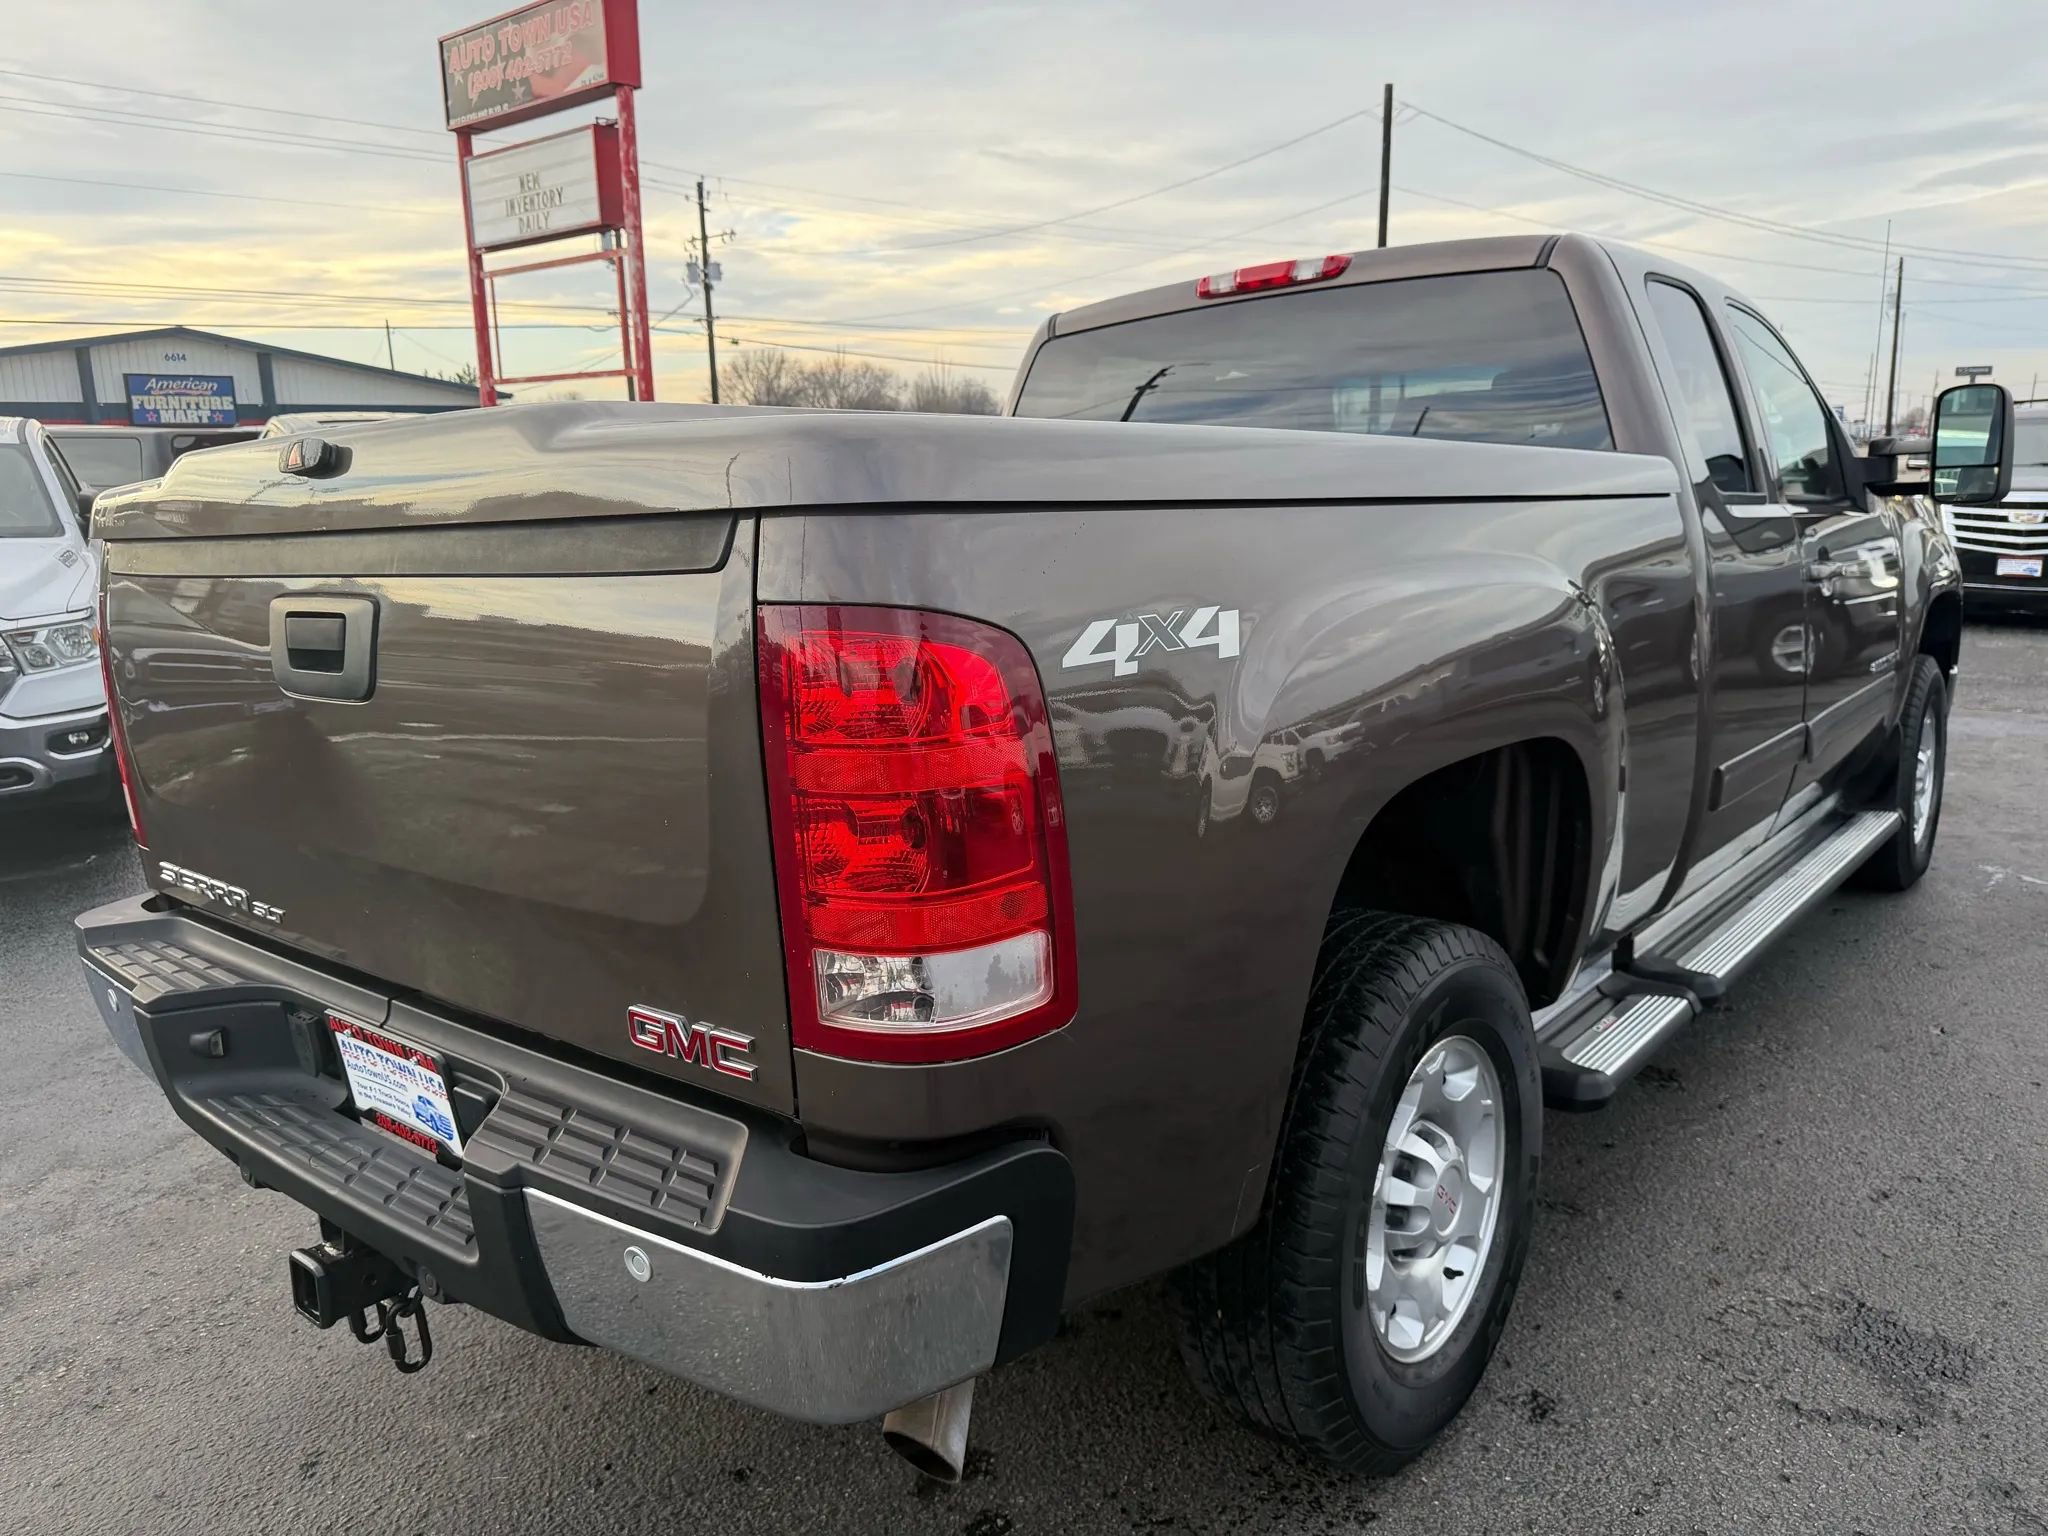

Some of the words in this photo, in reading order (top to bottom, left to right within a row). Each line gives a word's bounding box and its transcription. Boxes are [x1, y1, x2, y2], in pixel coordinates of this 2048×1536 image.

[448, 34, 496, 74] AUTO
[498, 13, 551, 56] TOWN
[555, 1, 594, 36] USA
[504, 186, 563, 217] INVENTORY
[518, 211, 550, 233] DAILY
[164, 353, 187, 362] 6614
[145, 377, 218, 392] American
[131, 395, 235, 411] FURNITURE
[160, 410, 212, 424] MART
[159, 861, 250, 912] SIERRA
[329, 1015, 364, 1041] AUTO
[364, 1029, 405, 1061] TOWN
[405, 1048, 437, 1073] USA
[627, 1003, 759, 1082] GMC
[340, 1039, 376, 1068] AUTO
[376, 1052, 417, 1086] TOWN
[1437, 1184, 1457, 1215] GMC
